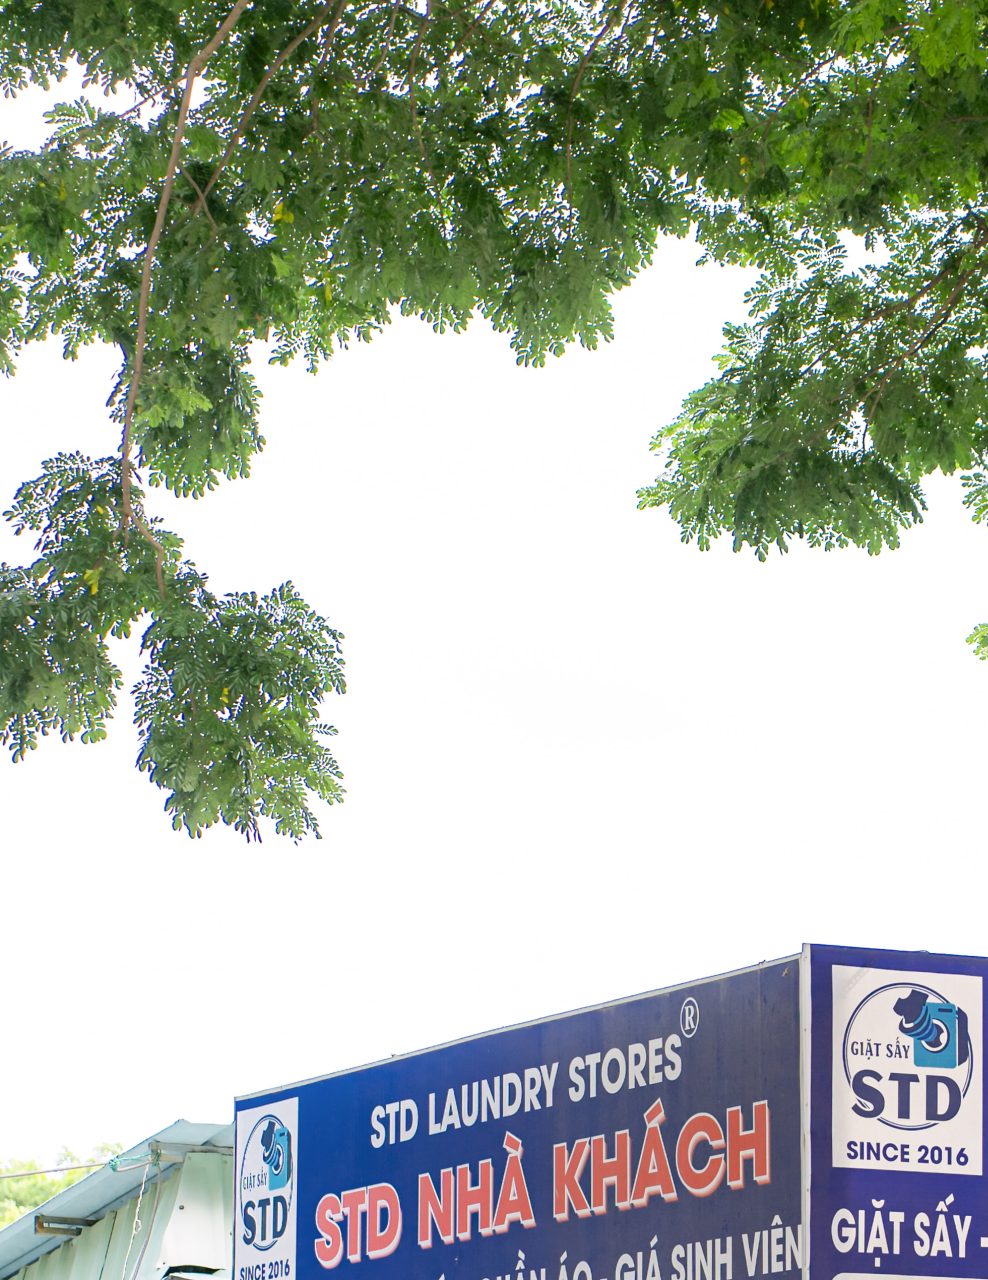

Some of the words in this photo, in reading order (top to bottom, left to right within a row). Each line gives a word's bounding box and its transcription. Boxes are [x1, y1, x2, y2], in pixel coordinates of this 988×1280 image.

[851, 1042, 881, 1056] GIẶT
[887, 1036, 908, 1058] SẤY
[371, 1099, 418, 1148] STD
[429, 1062, 559, 1138] LAUNDRY
[569, 1034, 681, 1105] STORES
[851, 1069, 962, 1124] STD
[242, 1176, 255, 1189] GIẶT
[258, 1166, 266, 1184] SẤY
[847, 1141, 909, 1162] SINCE
[918, 1145, 968, 1166] 2016
[314, 1180, 403, 1269] STD
[417, 1130, 537, 1250] NHÀ
[552, 1097, 774, 1223] KHÁCH
[242, 1194, 289, 1246] STD
[742, 1213, 805, 1278] VIÊN
[831, 1199, 904, 1267] GIẶT
[914, 1193, 972, 1258] SẤY
[269, 1259, 289, 1279] 2016
